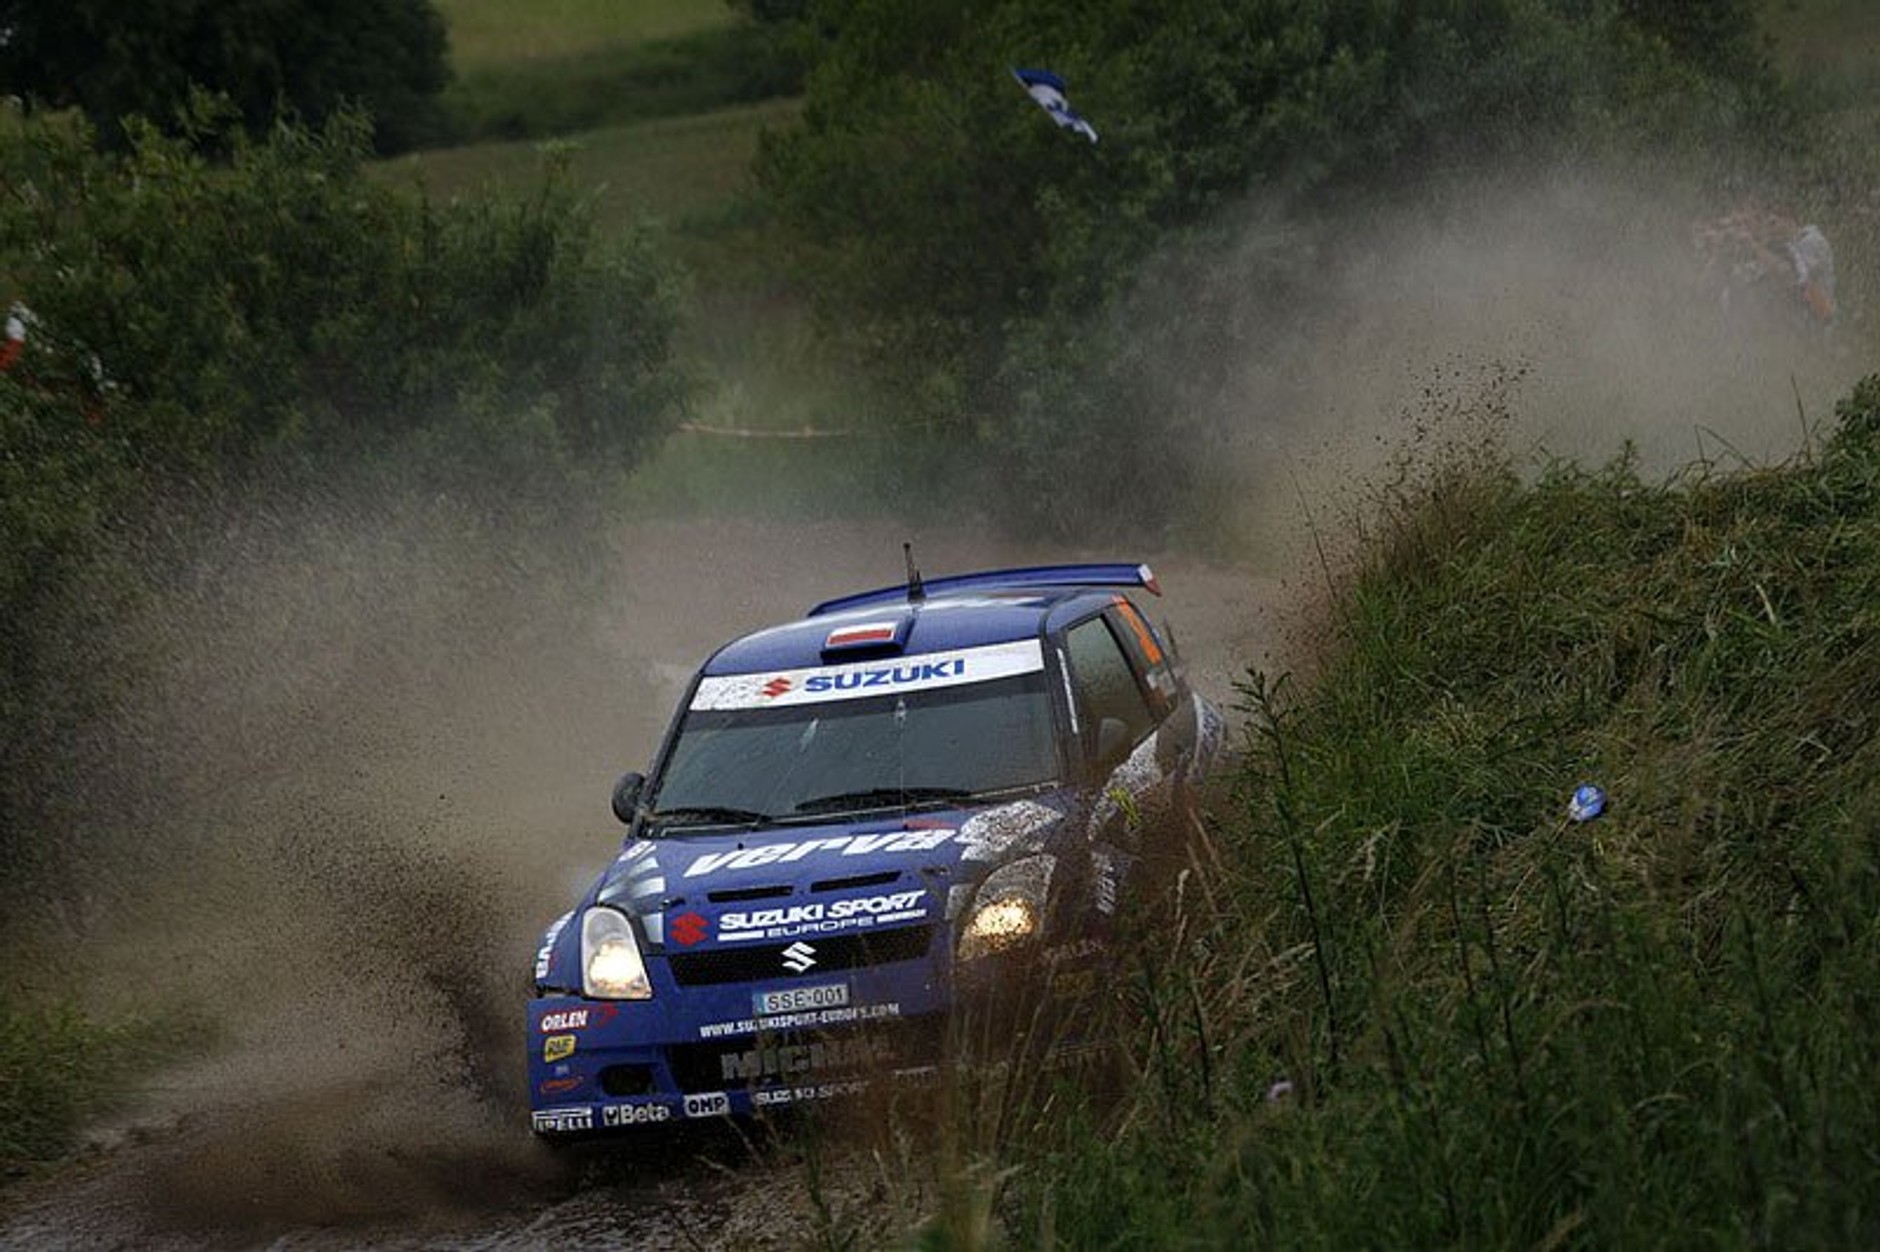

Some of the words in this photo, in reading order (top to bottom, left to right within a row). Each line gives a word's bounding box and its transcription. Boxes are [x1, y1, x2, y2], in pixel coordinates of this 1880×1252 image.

[804, 658, 964, 692] SUZUKI
[684, 829, 956, 877] verva
[719, 903, 824, 930] SUZUKI
[827, 889, 926, 918] SPORT
[767, 916, 874, 938] EUROPE
[541, 1010, 588, 1032] ORLEN
[621, 1102, 670, 1124] Beta
[688, 1097, 728, 1114] OMP
